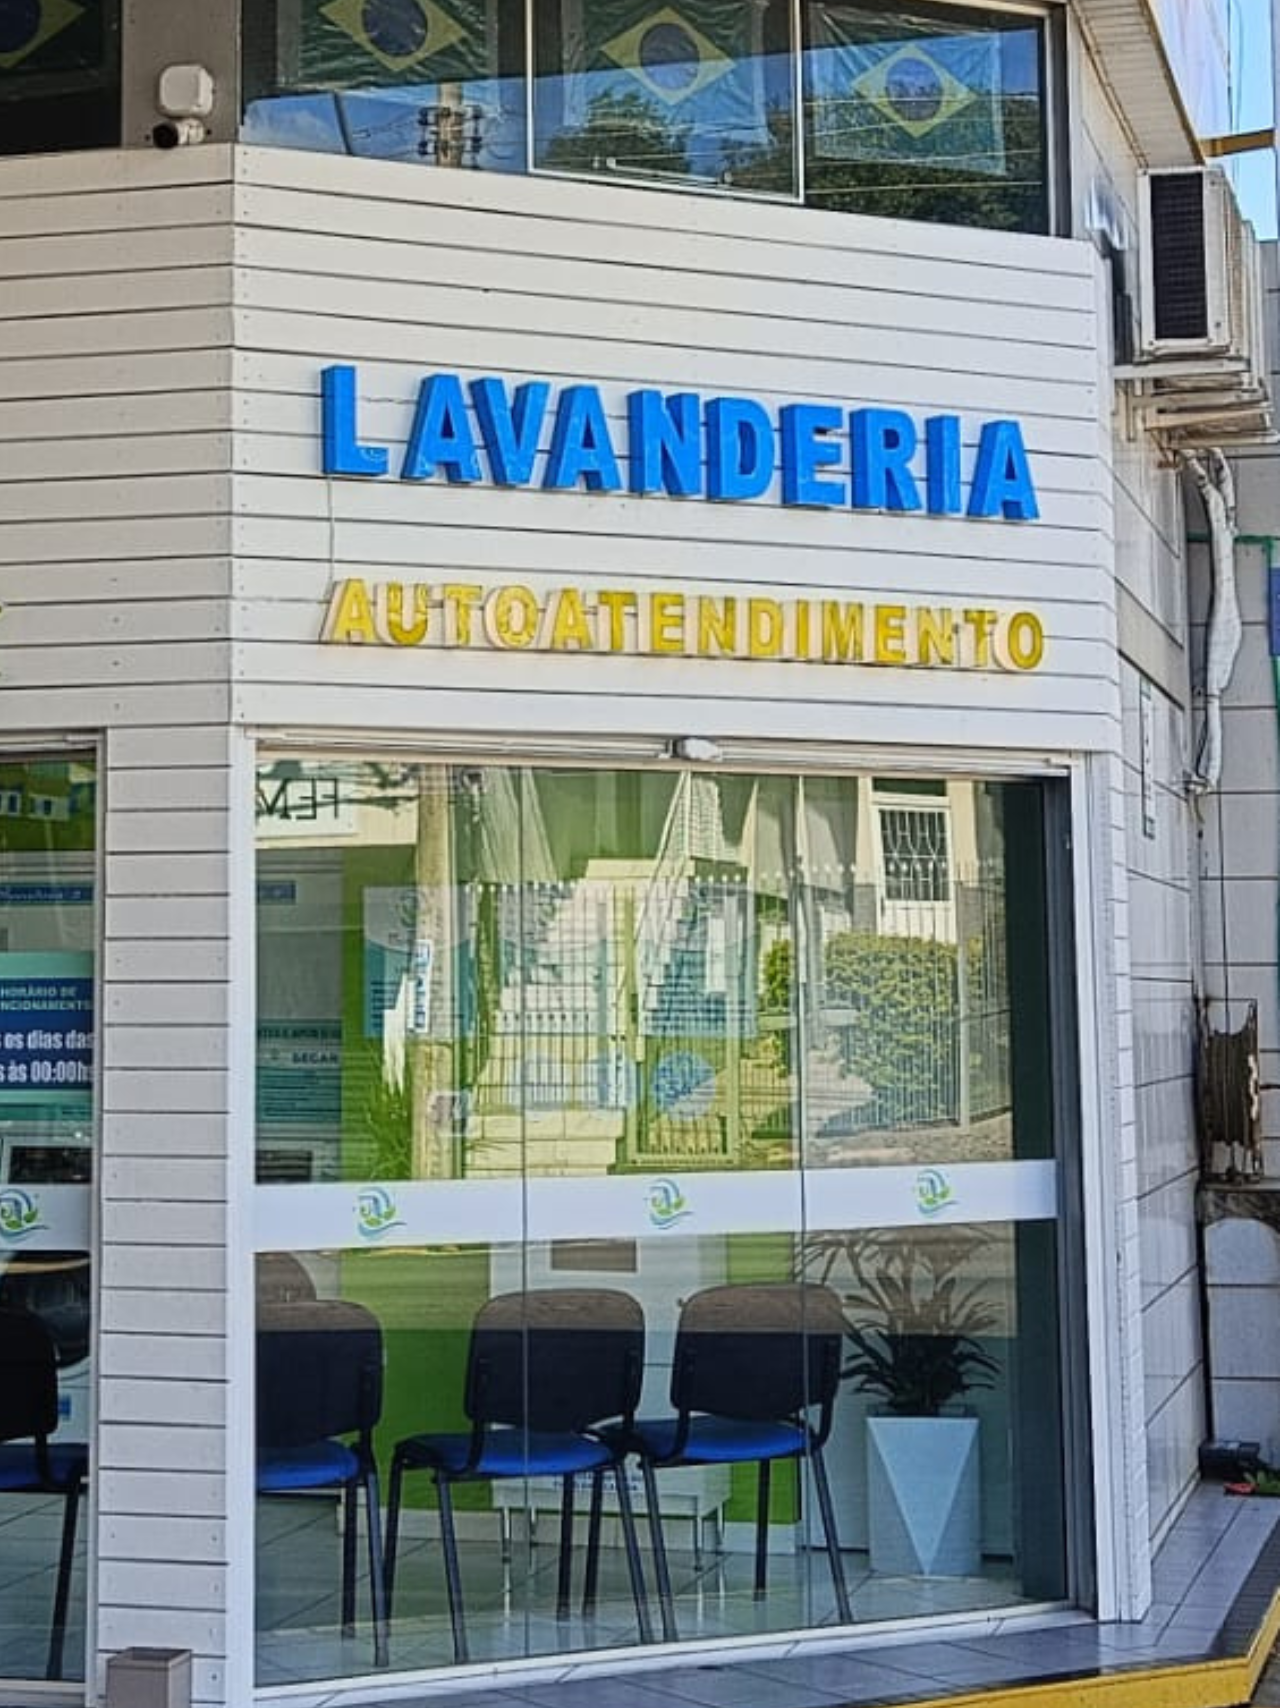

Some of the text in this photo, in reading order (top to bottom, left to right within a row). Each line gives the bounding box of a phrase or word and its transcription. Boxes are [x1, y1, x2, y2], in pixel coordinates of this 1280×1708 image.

[319, 364, 1041, 522] LAVANDERIA
[322, 577, 1044, 673] AUTOATENDIMENTO
[0, 984, 77, 998] HORÁRIO DE
[4, 1032, 24, 1049] os
[27, 1030, 63, 1049] dias
[65, 1030, 94, 1049] das
[7, 1059, 28, 1083] às
